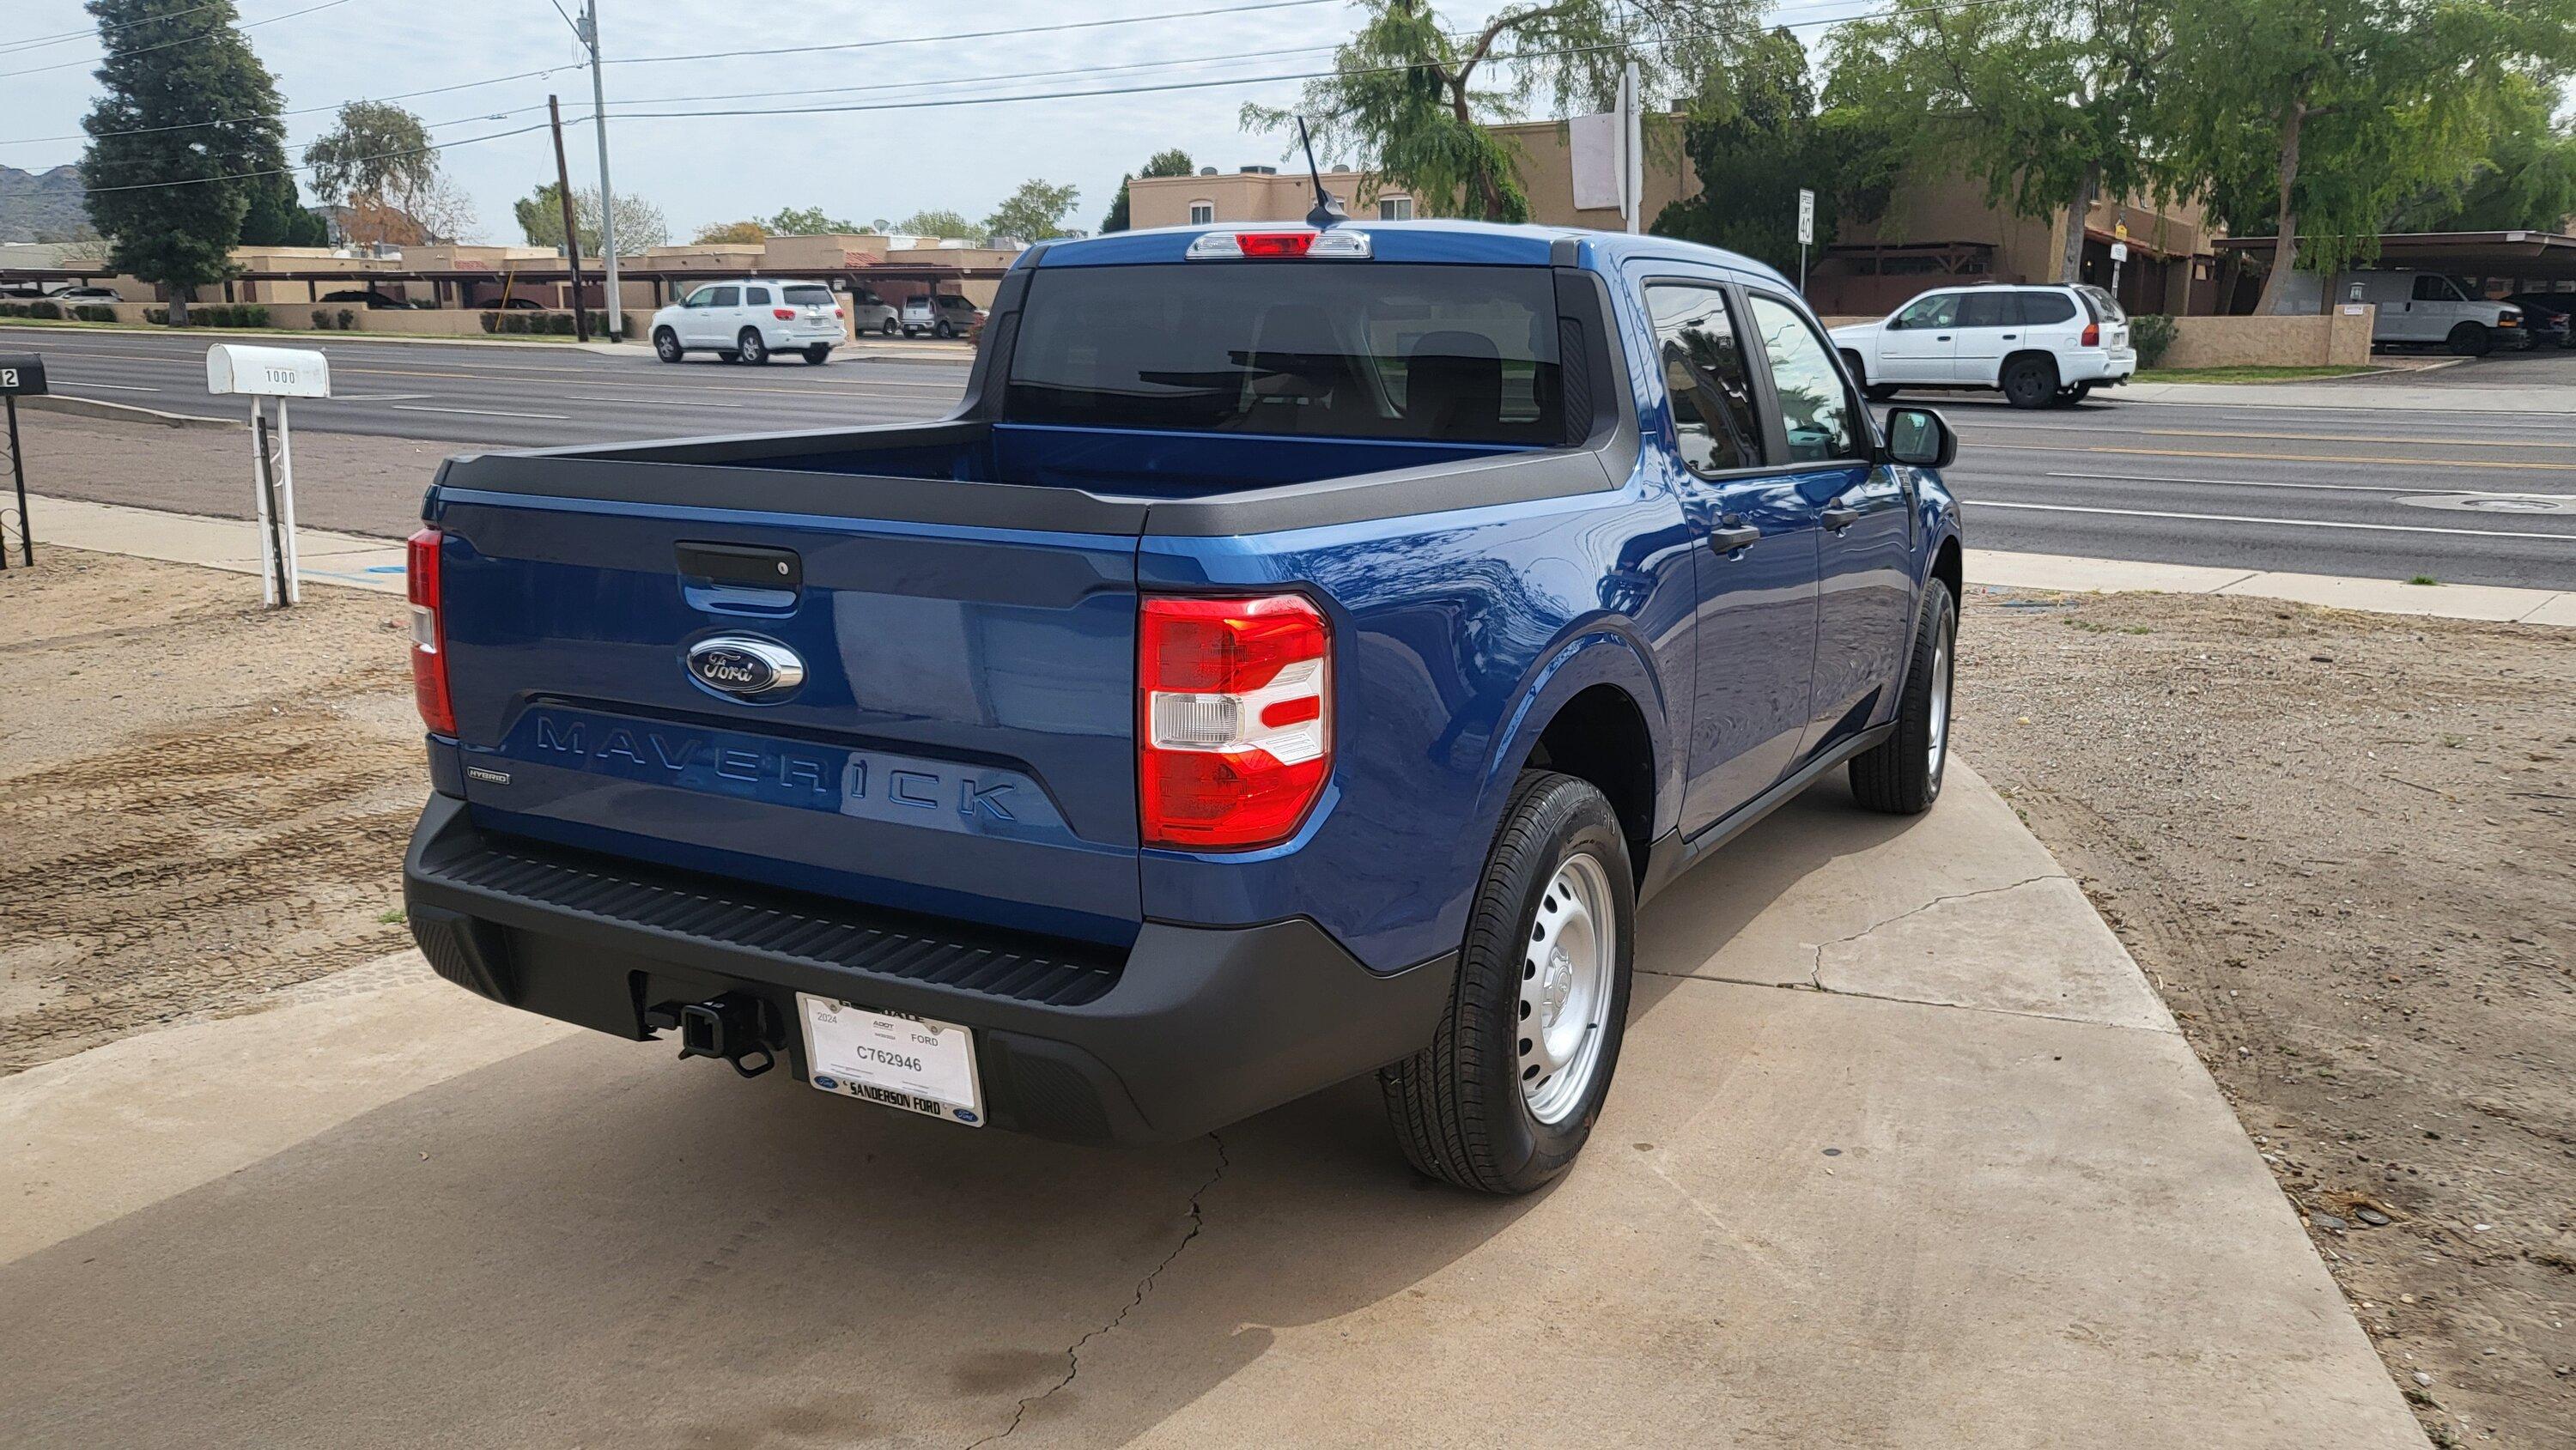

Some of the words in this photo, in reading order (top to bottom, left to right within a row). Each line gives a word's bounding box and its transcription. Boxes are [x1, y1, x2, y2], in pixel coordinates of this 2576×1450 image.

[1801, 217, 1810, 239] 40
[0, 369, 16, 385] 2
[265, 370, 295, 384] 1000
[703, 652, 754, 682] Ford
[470, 770, 507, 782] HYBRID
[537, 716, 1017, 821] MAVERICK
[817, 1012, 838, 1024] 2024
[911, 1034, 939, 1047] FORD
[856, 1046, 922, 1072] C762946
[850, 1082, 911, 1108] SANDERSON
[914, 1096, 941, 1115] FORD
